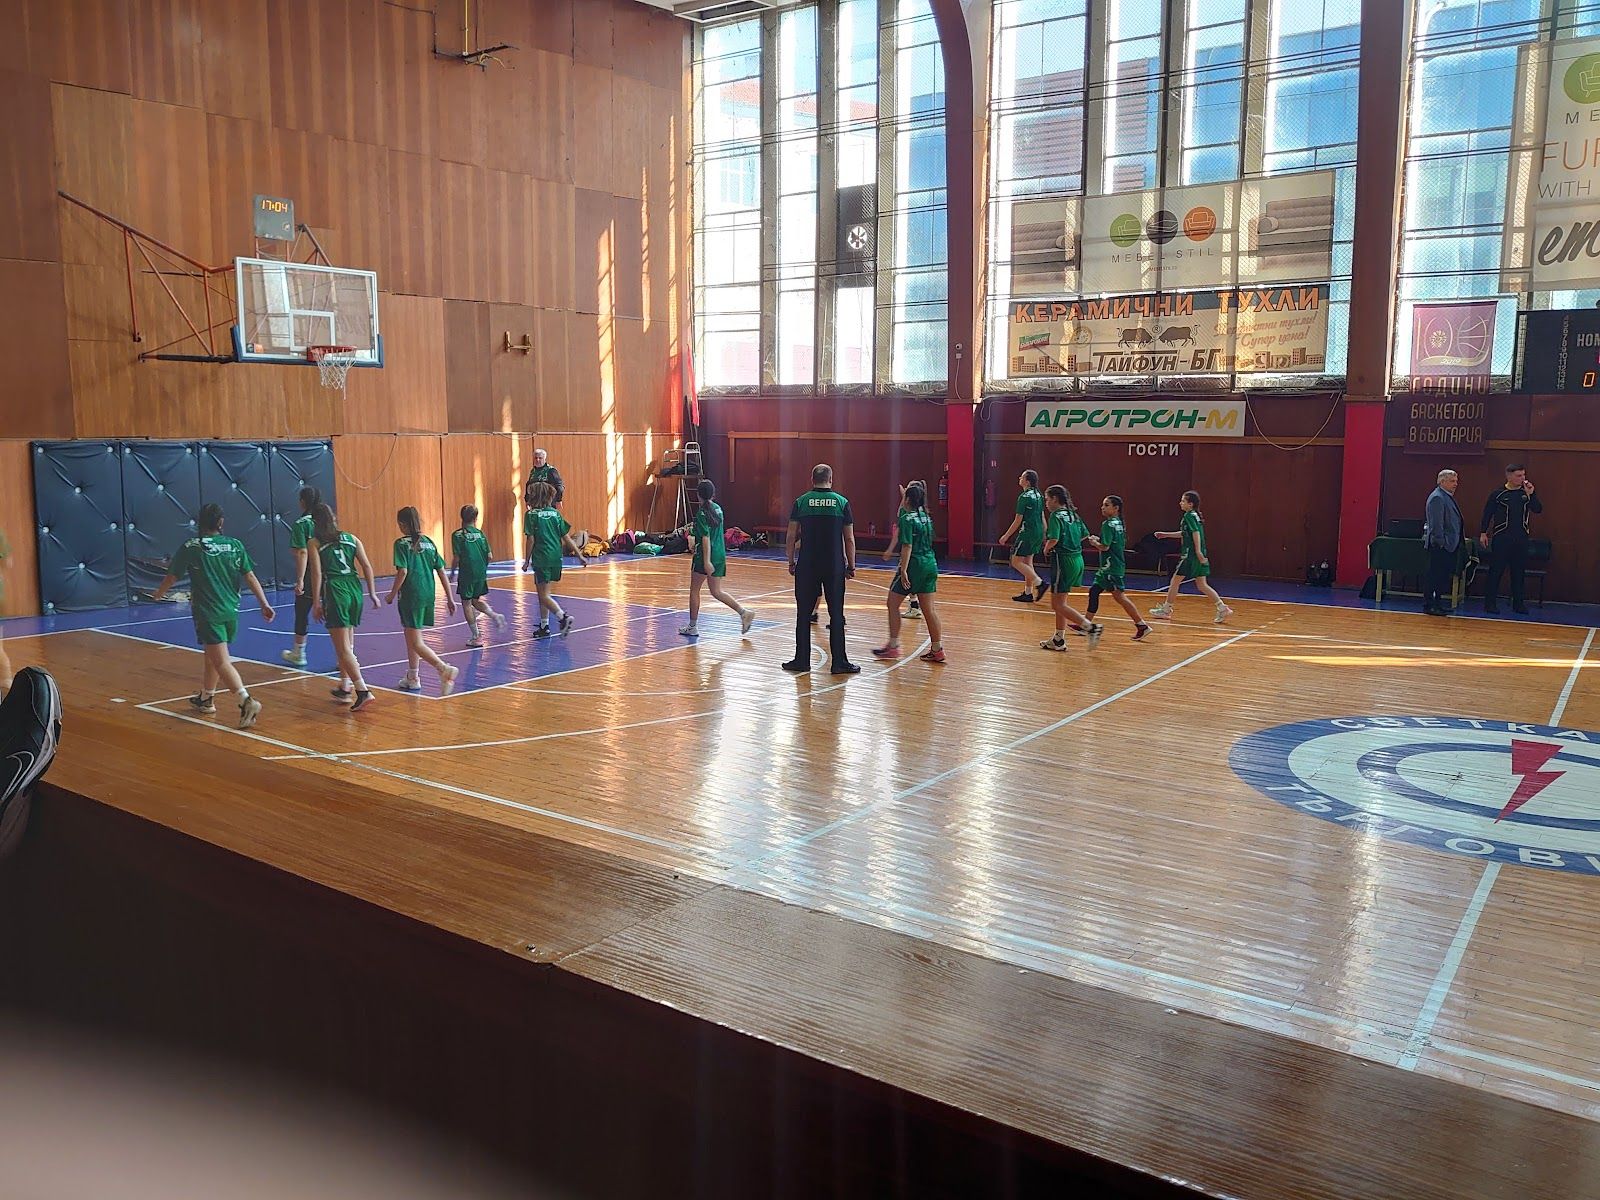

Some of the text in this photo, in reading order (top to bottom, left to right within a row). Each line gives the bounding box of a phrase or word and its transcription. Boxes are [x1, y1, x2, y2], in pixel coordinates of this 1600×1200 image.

[1537, 180, 1591, 198] WITH
[262, 199, 288, 213] 17:04
[1176, 247, 1214, 259] STIL
[1015, 288, 1320, 324] КЕРАМИЧНИ ТУХЛИ
[1412, 376, 1488, 398] ГОДИНИ
[1583, 372, 1595, 387] 0
[1030, 409, 1238, 430] АГРОТРОН-М
[1411, 402, 1484, 420] БАСКЕТБОЛ
[1409, 426, 1483, 443] В БЪЛГАРИЯ
[1128, 443, 1179, 456] ГОСТИ
